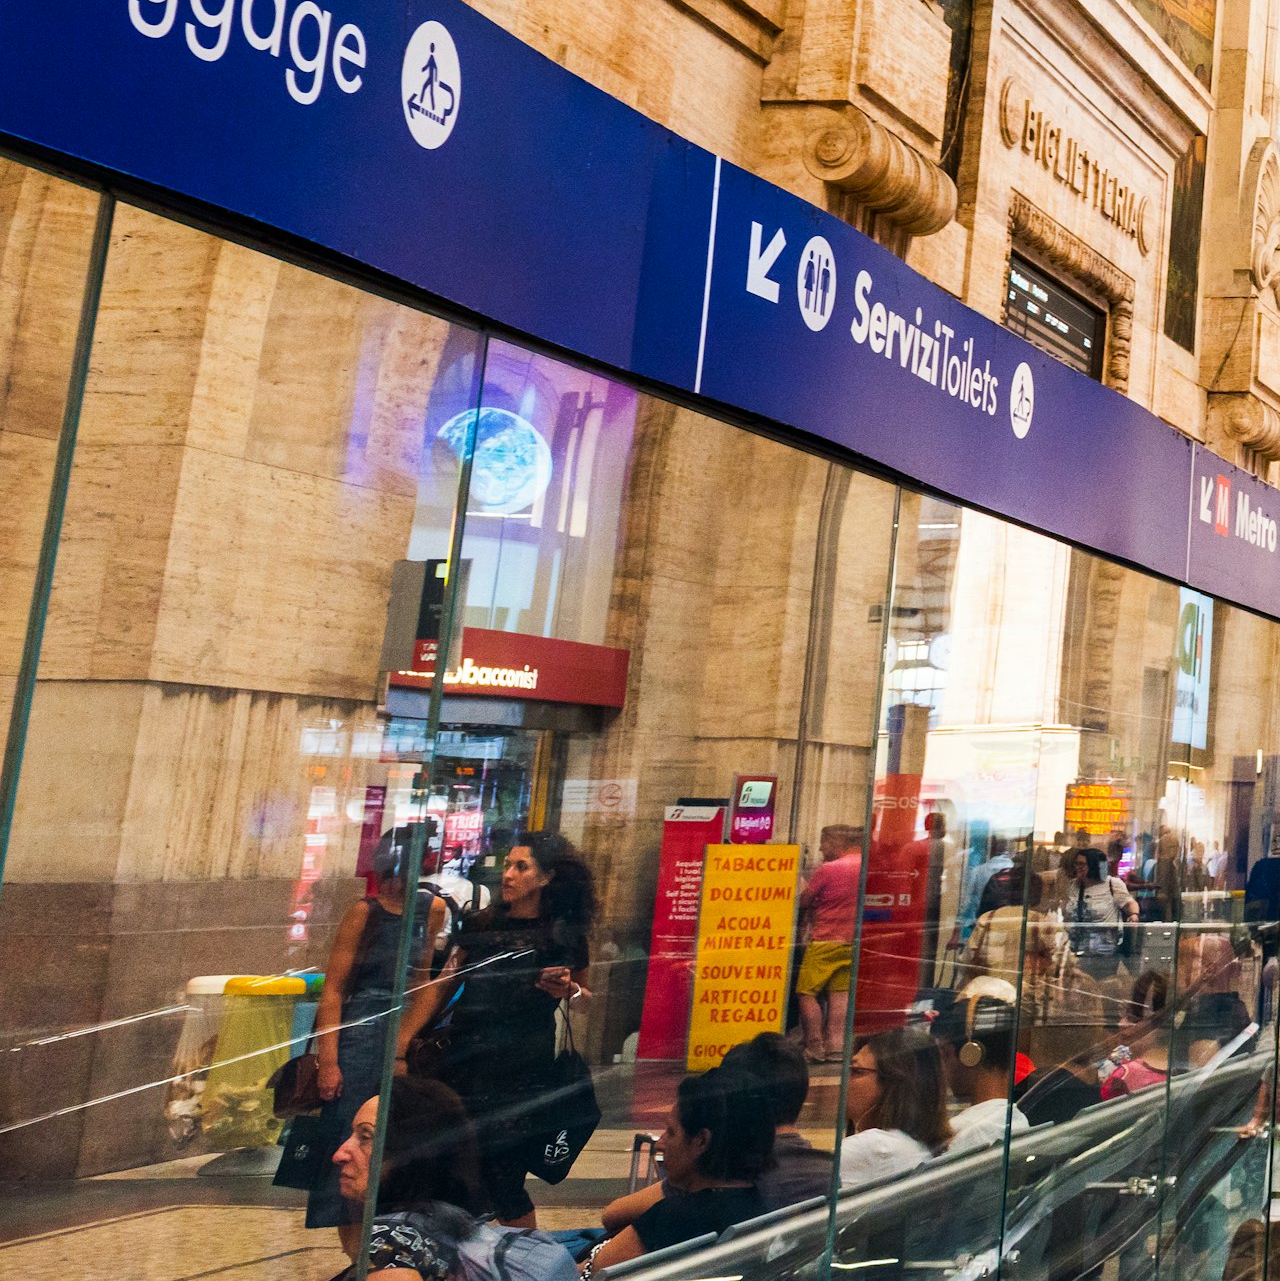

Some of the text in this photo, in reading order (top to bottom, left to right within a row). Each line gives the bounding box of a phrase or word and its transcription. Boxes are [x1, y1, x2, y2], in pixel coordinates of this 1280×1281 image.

[1021, 99, 1137, 238] BIGLIETTERIA
[851, 270, 941, 386] Servizi
[941, 324, 999, 416] Toilets
[1235, 490, 1277, 552] Metro
[714, 857, 794, 872] TABACCHI
[710, 887, 792, 901] DOLCIUMI
[717, 916, 771, 931] ACQUA
[703, 935, 785, 950] MINERALE
[701, 965, 782, 980] SOUVENIR
[700, 989, 777, 1004] ARTICOLI
[710, 1008, 778, 1023] REGALO
